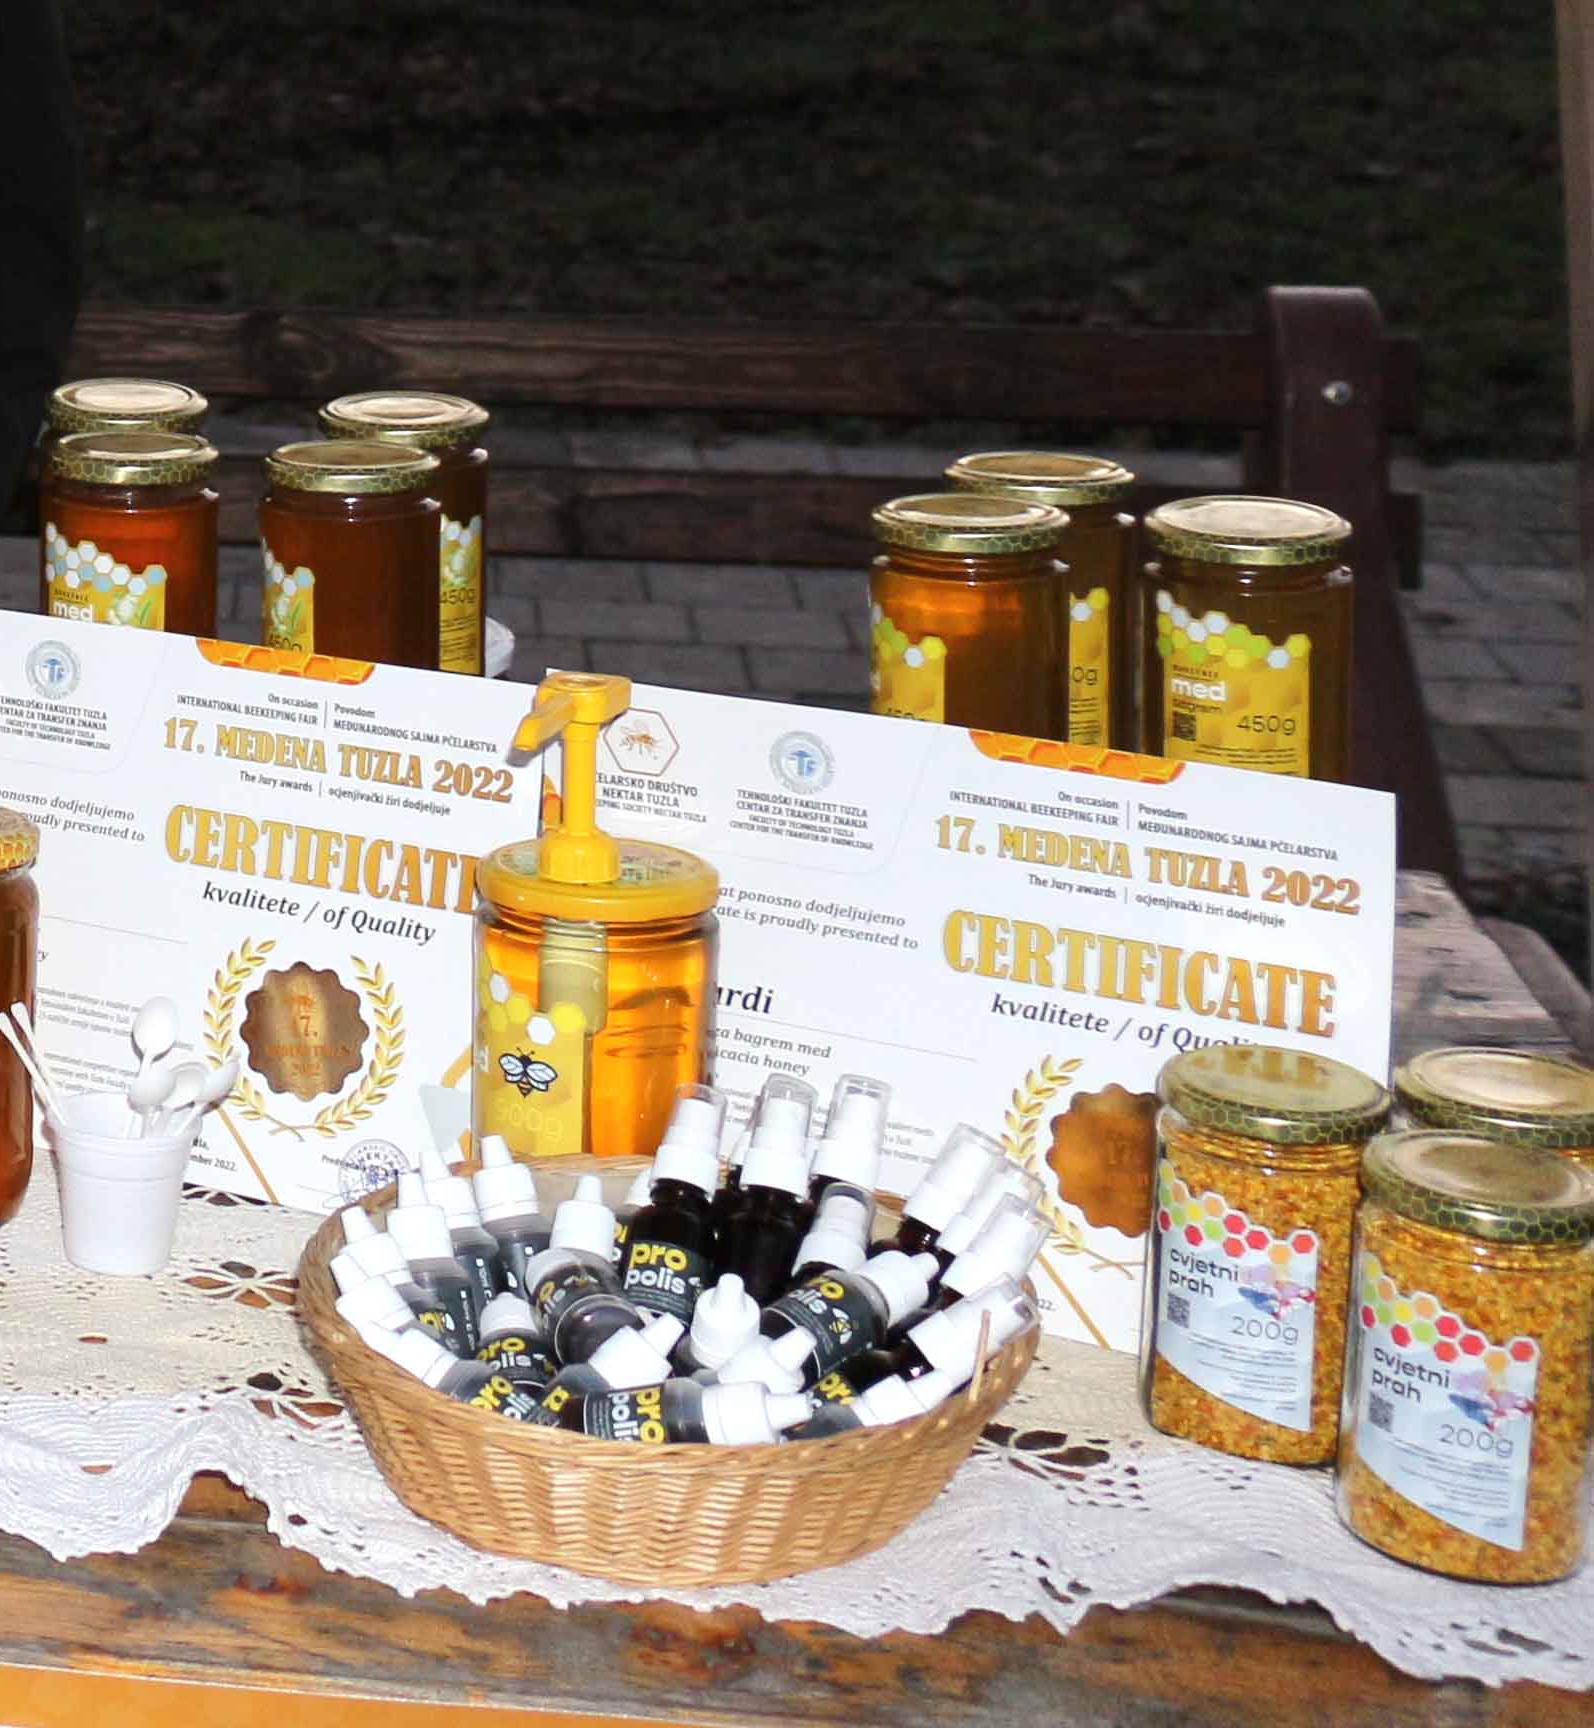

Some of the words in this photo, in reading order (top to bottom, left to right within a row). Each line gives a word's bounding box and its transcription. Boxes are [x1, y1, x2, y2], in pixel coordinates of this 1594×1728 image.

[268, 692, 280, 704] On
[282, 695, 318, 710] occasion
[1171, 678, 1227, 701] med
[176, 694, 242, 715] INTERNATIONAL
[244, 704, 296, 724] BEEKEEPING
[298, 712, 318, 725] FAIR
[334, 703, 375, 719] Povodom
[1236, 715, 1296, 736] 450g
[410, 730, 440, 745] SAJMA
[441, 734, 497, 754] PČELARSTVA
[164, 717, 205, 753] 17.
[214, 723, 328, 774] MEDENA
[338, 743, 424, 789] TUZLA
[432, 759, 515, 804] 2022
[240, 770, 256, 784] The
[258, 773, 279, 790] Jury
[280, 779, 313, 793] awards
[596, 772, 645, 790] ELARSKO
[647, 776, 698, 798] DRUŠTVO
[51, 789, 135, 822] dodjeljujemo
[403, 793, 451, 816] dodjeljuje
[602, 788, 644, 802] NEKTAR
[645, 793, 681, 808] TUZLA
[736, 800, 770, 815] CENTAR
[771, 804, 785, 816] ZA
[786, 807, 832, 824] TRANSFER
[794, 797, 837, 814] FAKULTET
[839, 804, 869, 818] TUZLA
[949, 790, 1028, 815] INTERNATIONAL
[1030, 801, 1093, 825] BEEKEEPING
[1095, 813, 1119, 827] FAIR
[1058, 790, 1073, 803] On
[1074, 794, 1119, 810] occasion
[1137, 803, 1188, 821] Povodom
[63, 817, 128, 841] presented
[131, 829, 145, 842] to
[1230, 832, 1268, 850] SAJMA
[1270, 838, 1339, 863] PČELARSTVA
[935, 815, 986, 856] 17.
[998, 823, 1133, 879] MEDENA
[1145, 846, 1250, 899] TUZLA
[1261, 866, 1362, 917] 2022
[1028, 874, 1048, 888] The
[1049, 877, 1074, 896] Jury
[1076, 884, 1117, 900] awards
[202, 881, 301, 917] kvalitete
[323, 906, 349, 931] of
[350, 909, 437, 947] Quality
[737, 886, 802, 912] ponosno
[806, 890, 907, 928] dodjeljujemo
[1135, 892, 1203, 915] ocjenjivački
[1226, 904, 1286, 928] dodjeljuje
[744, 906, 757, 921] is
[758, 912, 819, 935] proudly
[821, 919, 900, 948] presented
[902, 932, 919, 950] to
[943, 909, 1339, 1038] CERTIFICATE
[715, 985, 774, 1014] rdi
[991, 992, 1109, 1033] kvalitete
[1138, 1022, 1168, 1049] of
[733, 1028, 793, 1051] bagrem
[797, 1044, 832, 1059] med
[763, 1054, 810, 1076] honey
[629, 1242, 688, 1271] pro
[1169, 1247, 1240, 1282] cvjetni
[624, 1267, 687, 1294] polis
[1168, 1268, 1215, 1298] prah
[1231, 1315, 1300, 1346] 200g
[1373, 1346, 1452, 1389] cvjetni
[1371, 1367, 1422, 1403] prah
[608, 1390, 639, 1442] poli
[636, 1387, 666, 1443] pro
[1440, 1423, 1514, 1458] 200g
